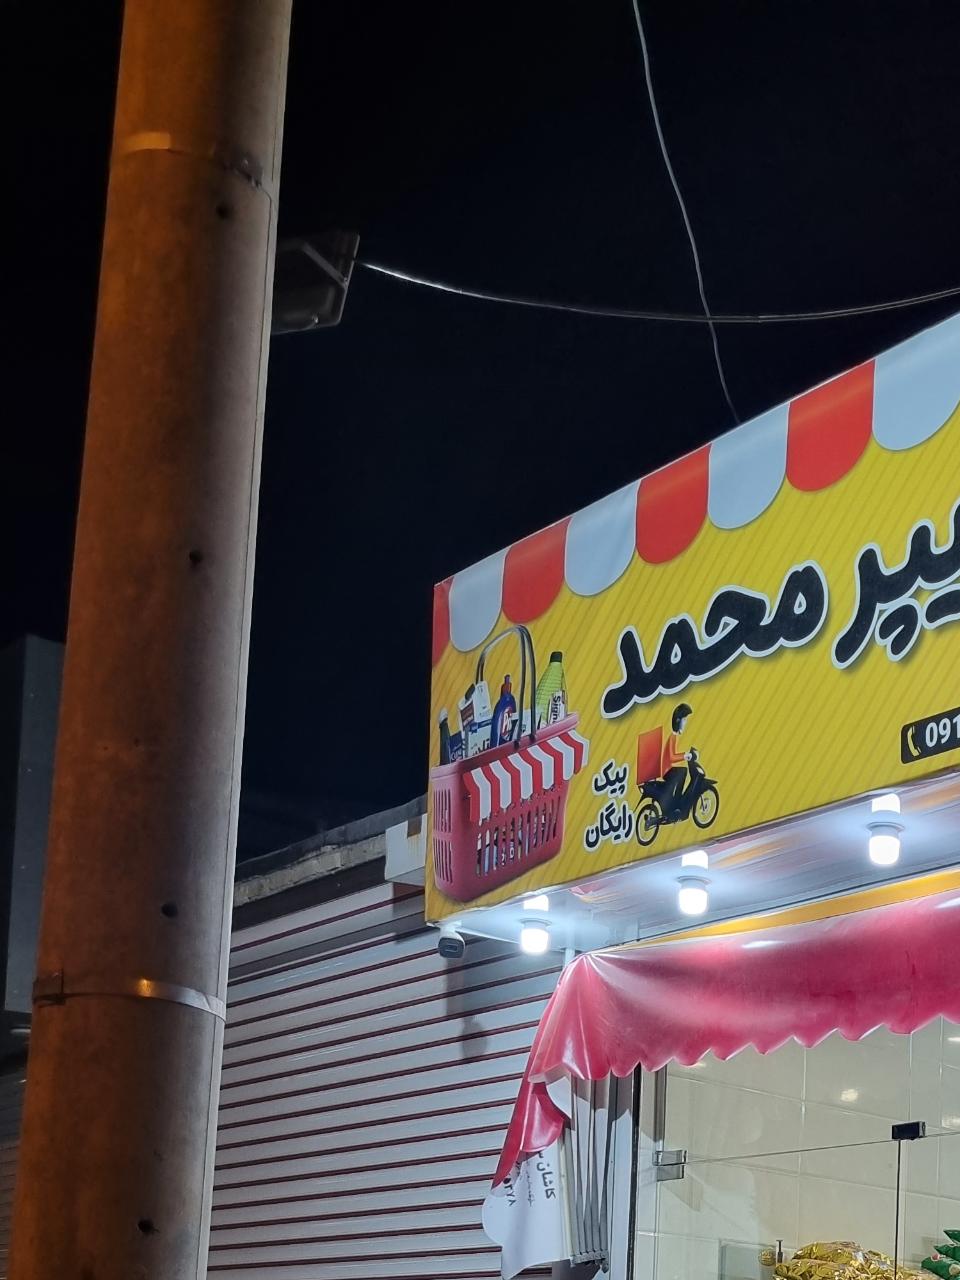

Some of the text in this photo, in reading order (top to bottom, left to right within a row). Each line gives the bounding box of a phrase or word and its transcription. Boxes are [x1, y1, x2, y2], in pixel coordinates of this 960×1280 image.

[602, 560, 828, 718] محمد
[593, 760, 628, 796] پیک
[584, 801, 634, 850] رایگان
[536, 1162, 557, 1199] کاشان
